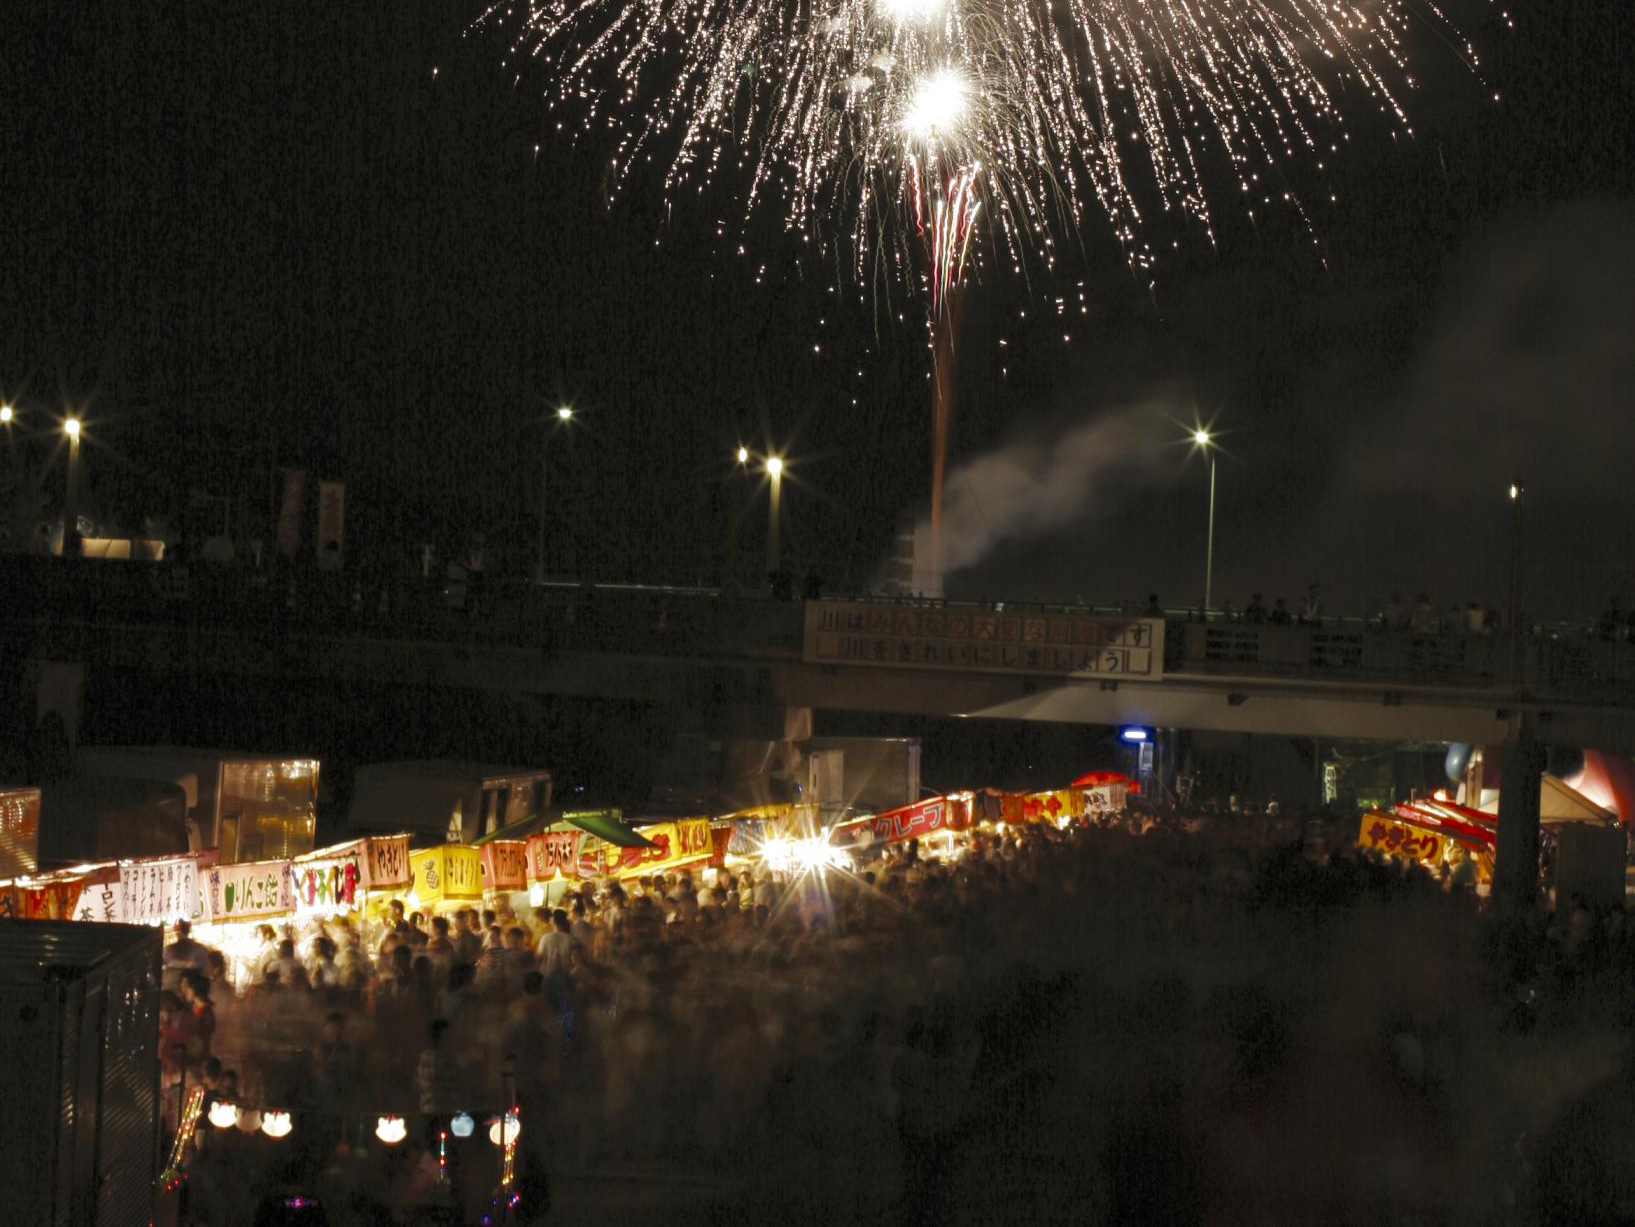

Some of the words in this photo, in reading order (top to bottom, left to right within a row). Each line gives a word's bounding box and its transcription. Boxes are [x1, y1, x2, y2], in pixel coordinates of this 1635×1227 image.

[845, 636, 1119, 672] 川をきれいにしましょう
[874, 801, 945, 840] クレープ
[1367, 821, 1439, 859] やきとり
